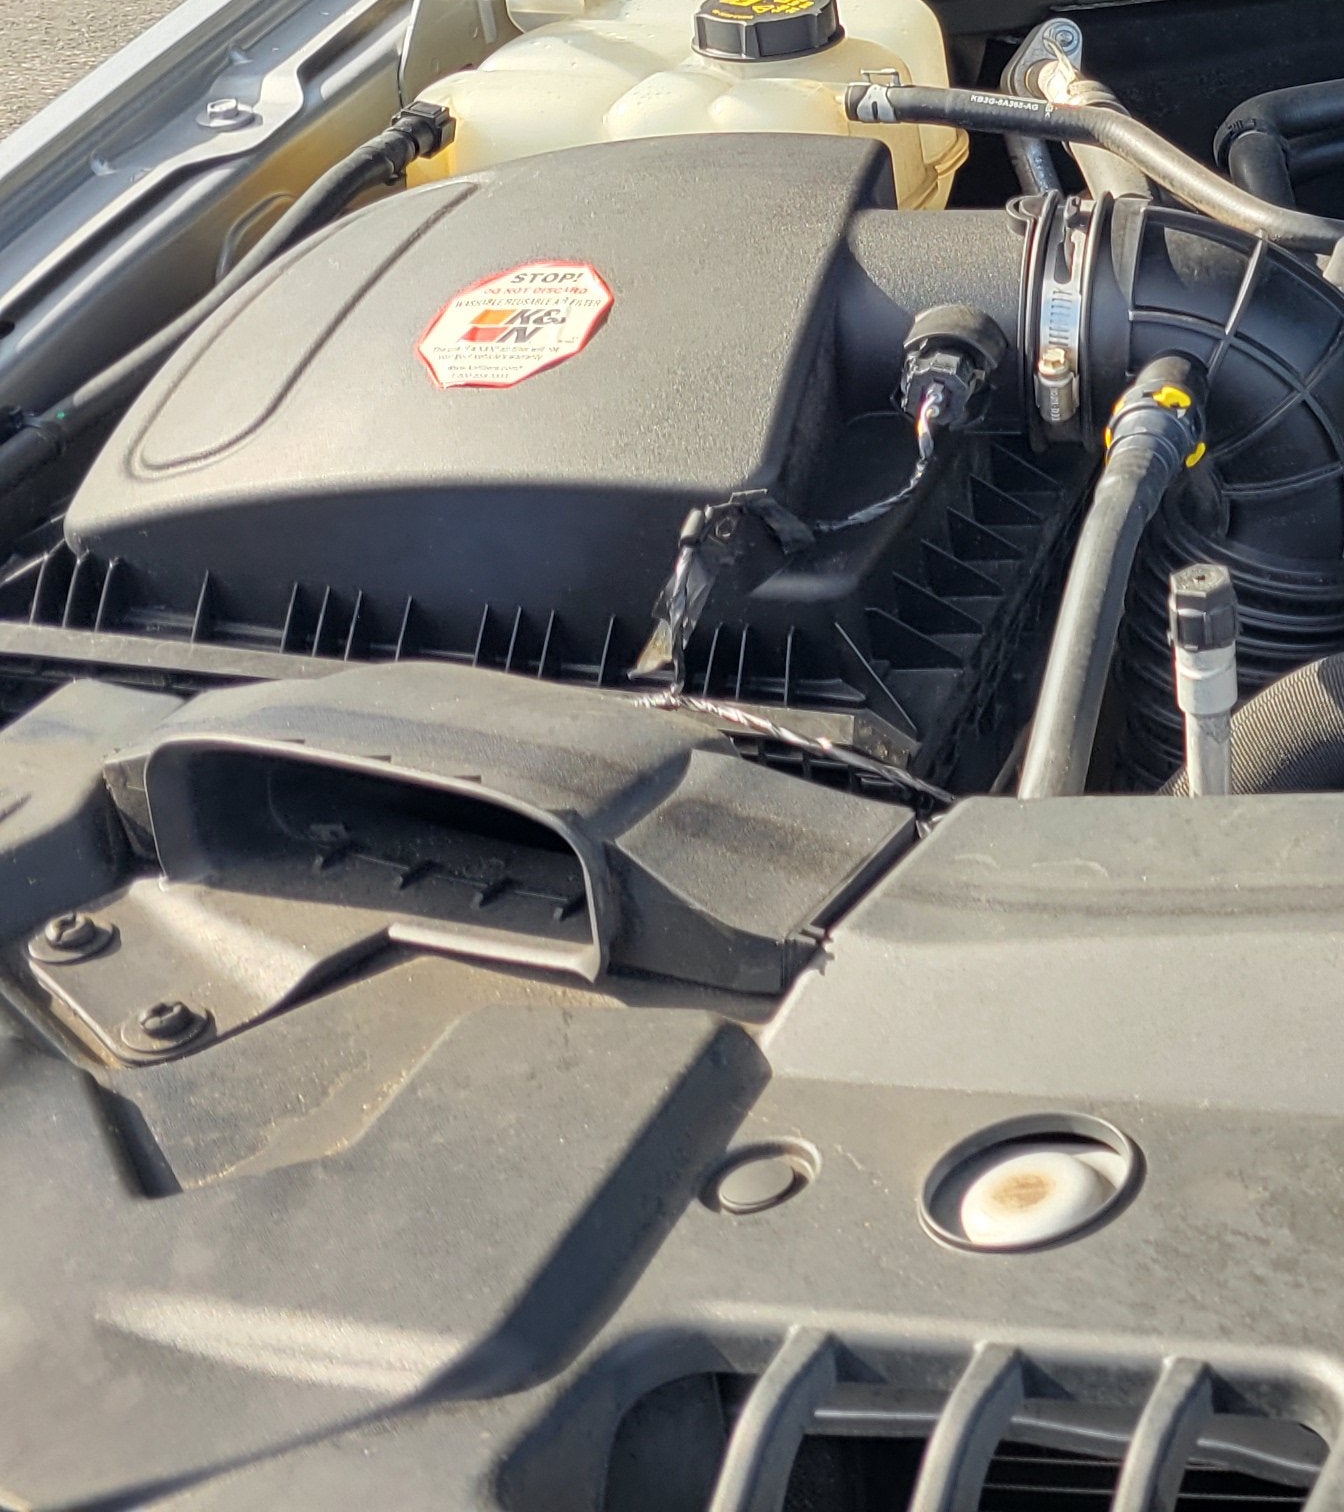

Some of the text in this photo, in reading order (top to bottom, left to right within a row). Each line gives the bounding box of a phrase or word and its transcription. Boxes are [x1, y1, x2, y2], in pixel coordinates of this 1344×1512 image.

[511, 272, 584, 284] STOP!
[503, 286, 530, 295] NOT
[532, 285, 589, 295] DISCARD
